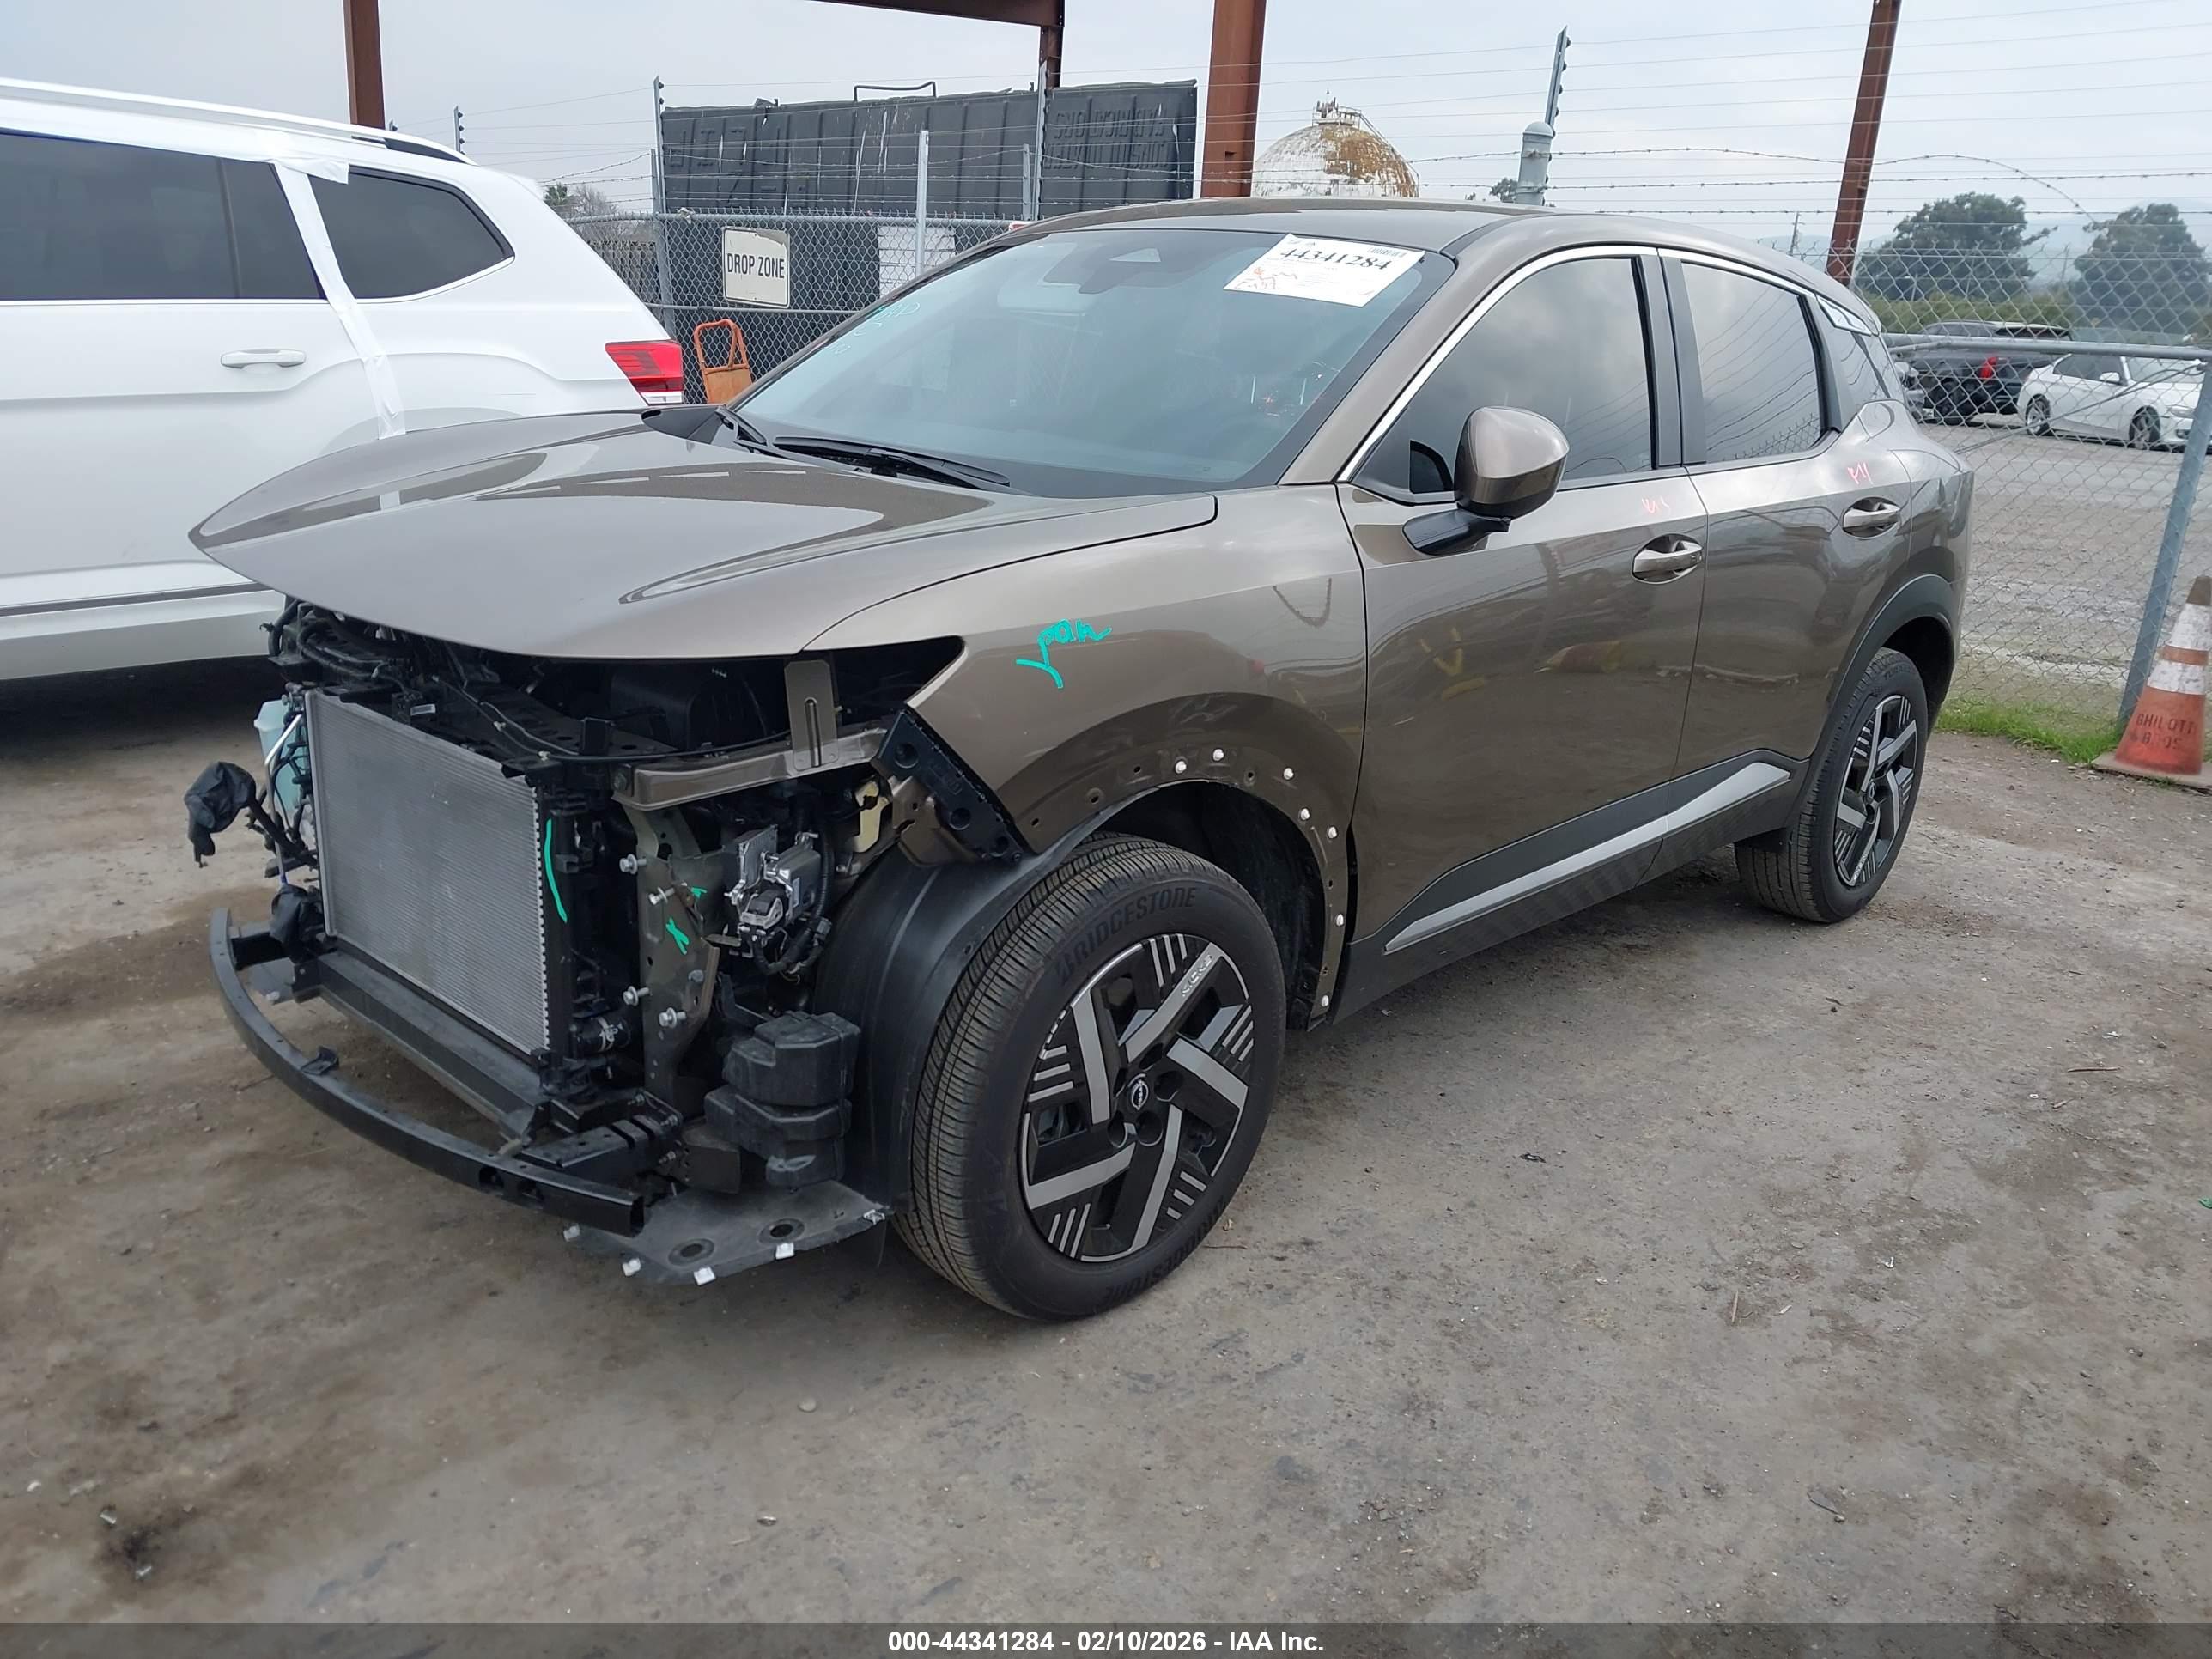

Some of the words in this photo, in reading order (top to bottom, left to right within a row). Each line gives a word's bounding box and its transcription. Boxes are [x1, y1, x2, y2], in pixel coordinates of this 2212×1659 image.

[727, 253, 756, 275] DROP
[757, 256, 785, 279] ZONE
[1279, 247, 1392, 270] 44341284
[1057, 885, 1198, 986] BRIDGESTONE
